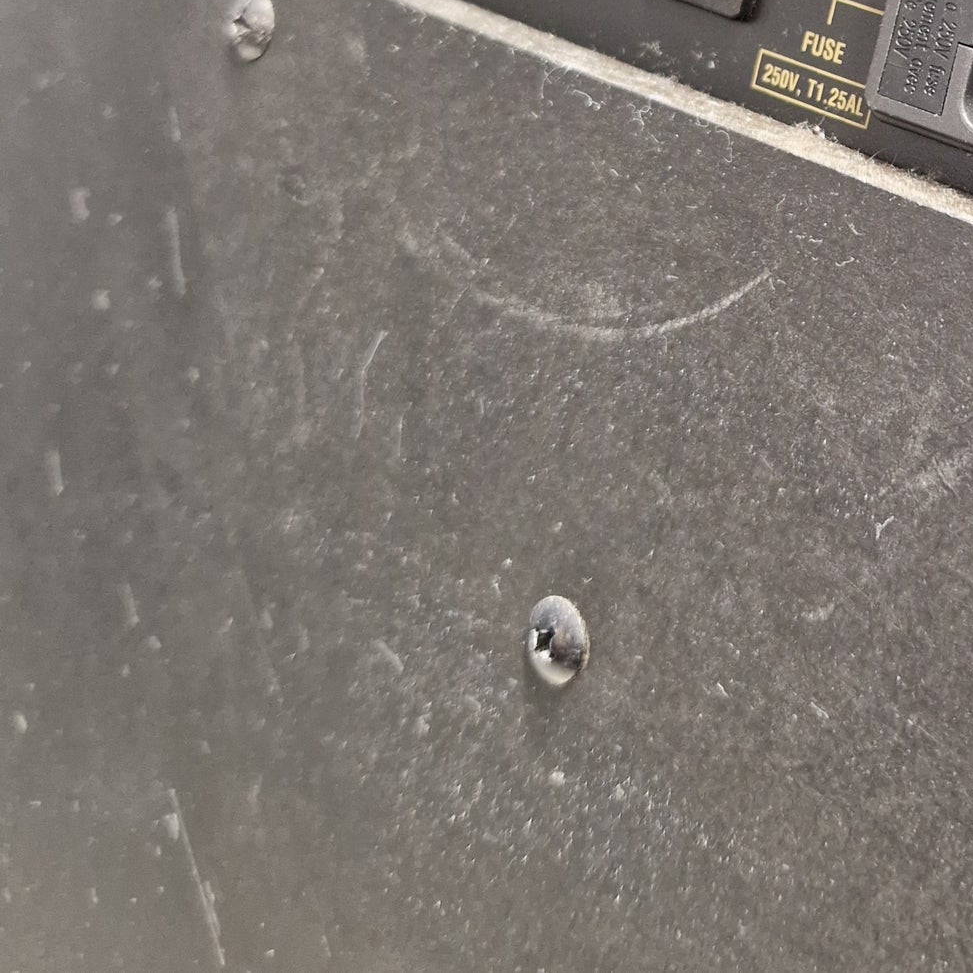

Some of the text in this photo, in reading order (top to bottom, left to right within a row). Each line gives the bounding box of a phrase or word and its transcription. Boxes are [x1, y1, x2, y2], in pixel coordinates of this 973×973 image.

[801, 30, 846, 65] FUSE
[761, 63, 864, 117] 250V, T1.25AL
